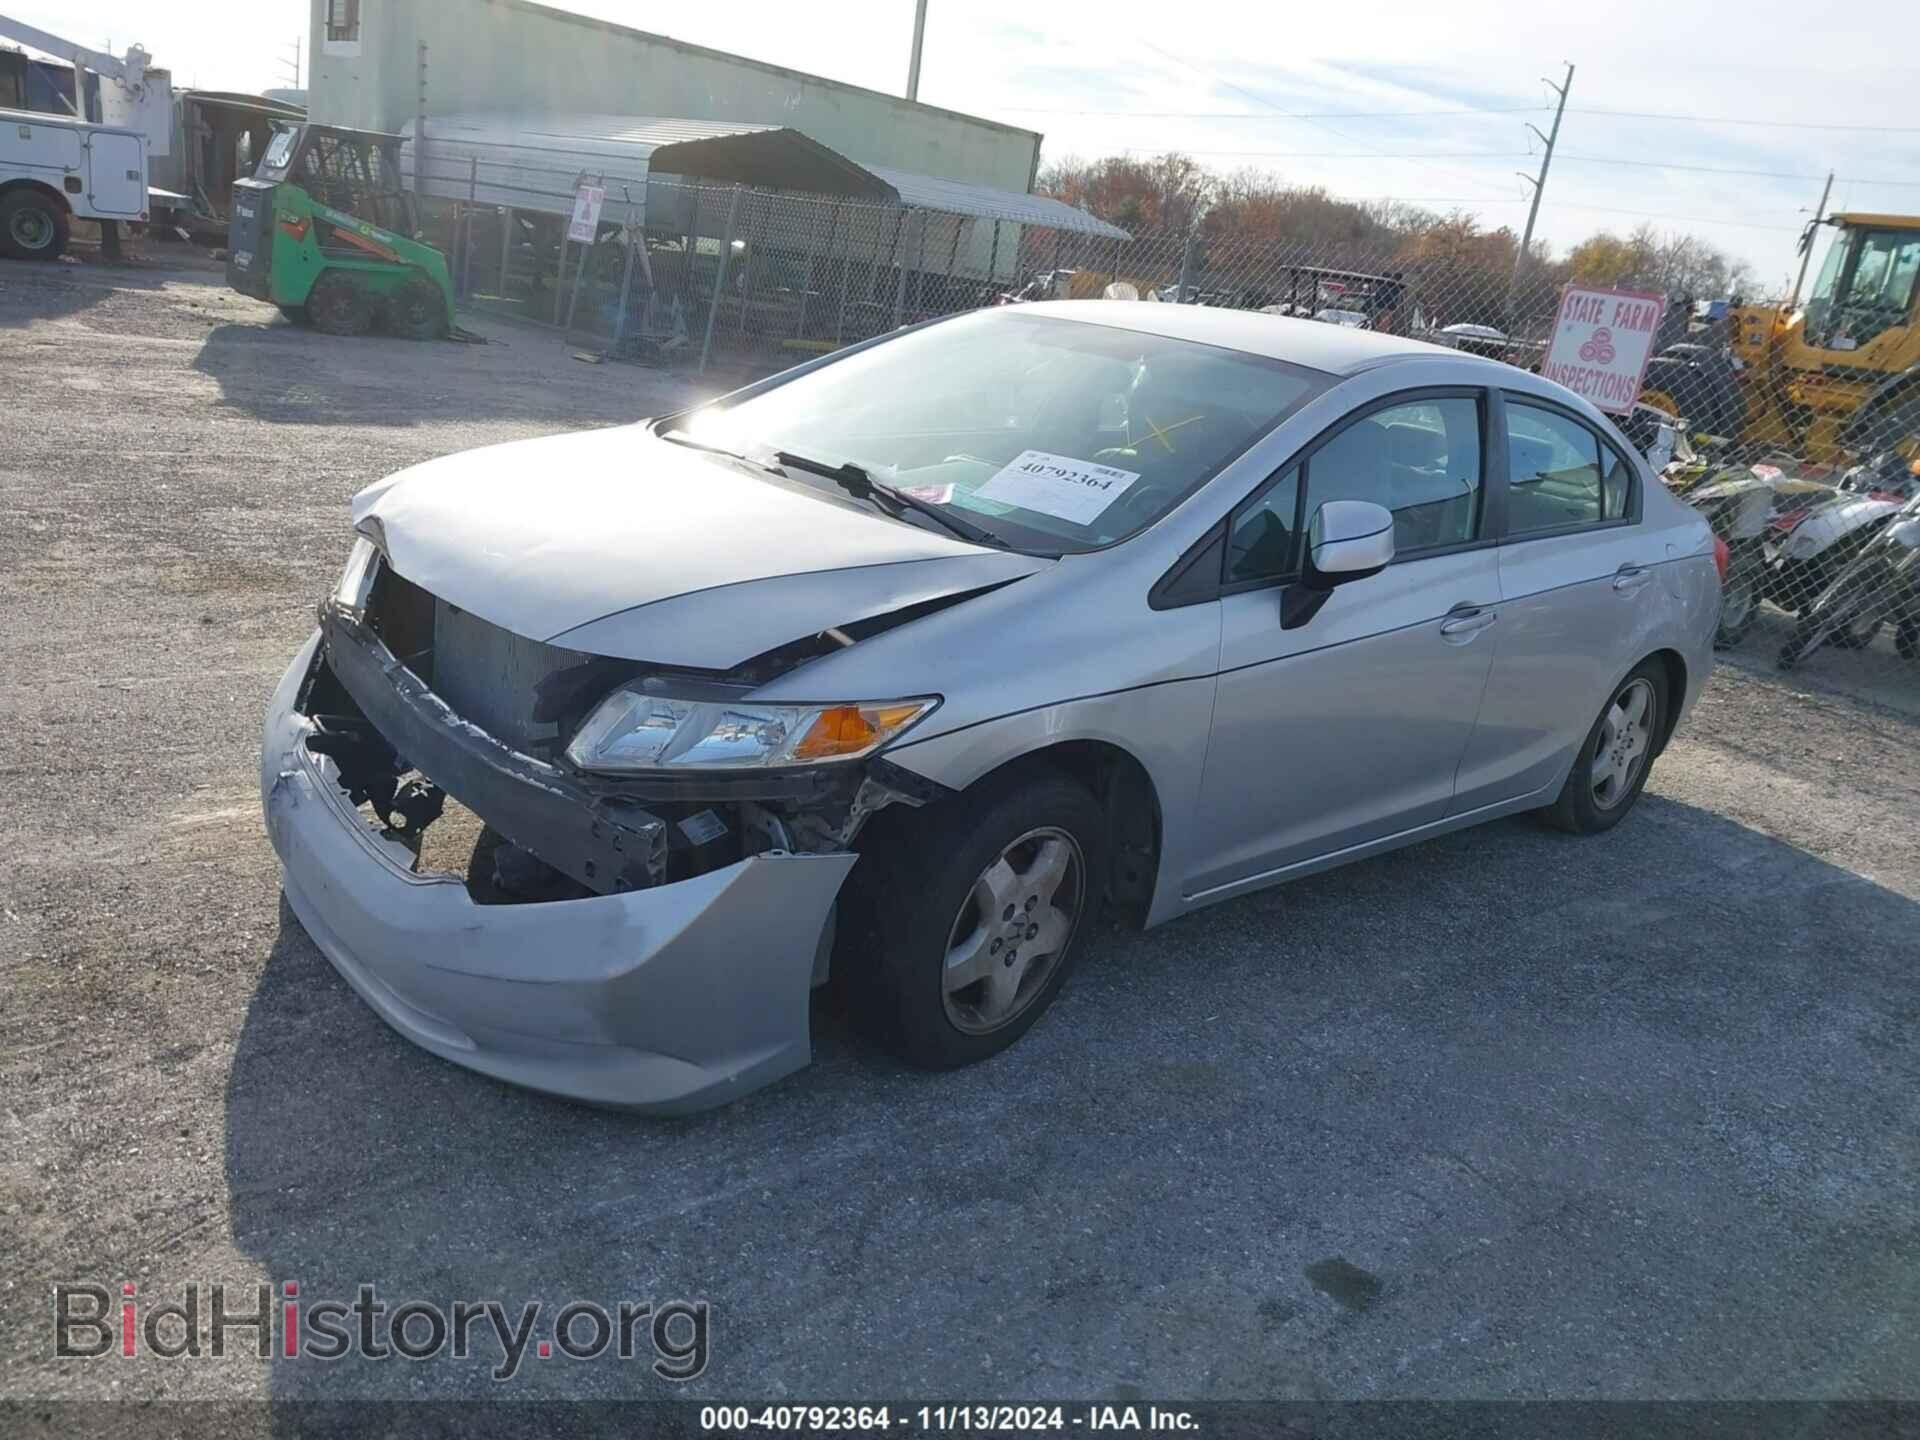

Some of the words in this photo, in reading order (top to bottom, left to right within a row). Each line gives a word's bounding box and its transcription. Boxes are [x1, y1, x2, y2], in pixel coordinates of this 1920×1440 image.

[1564, 295, 1606, 325] STATE
[1612, 302, 1657, 332] FARM
[1545, 361, 1636, 402] INSPECTIONS
[1020, 462, 1113, 491] 40792364
